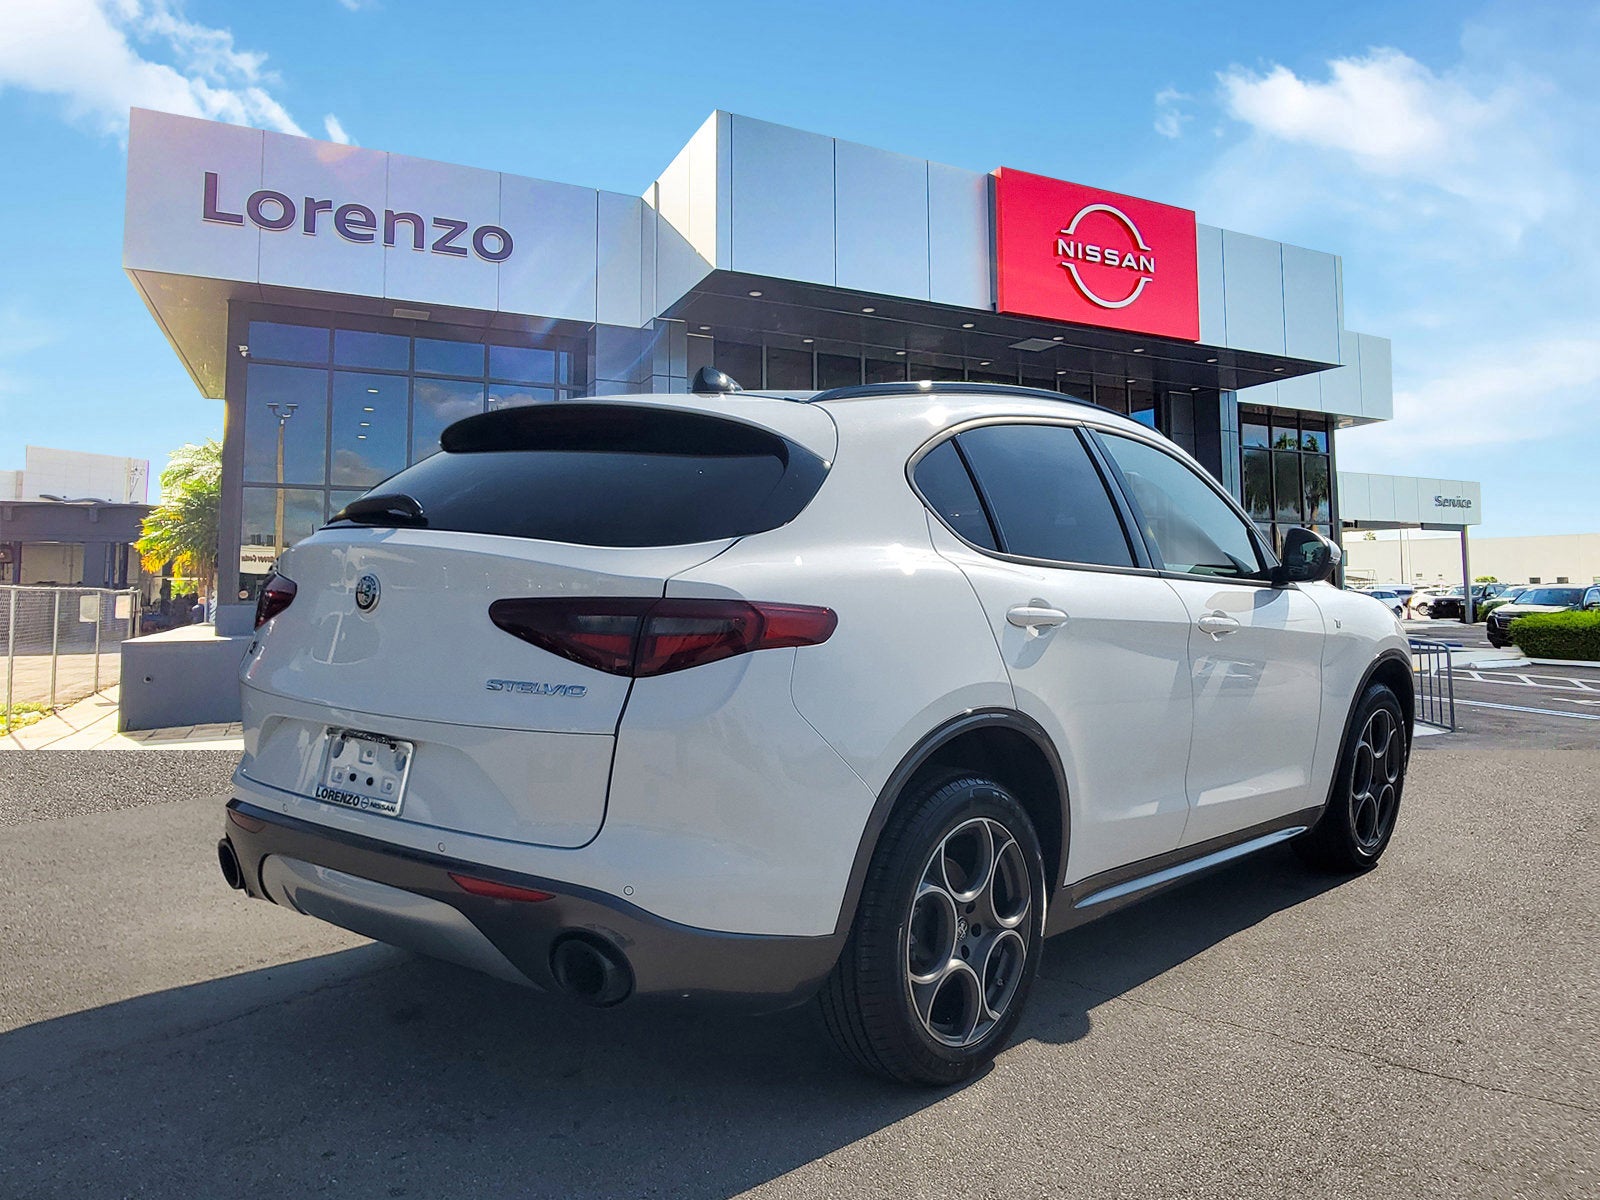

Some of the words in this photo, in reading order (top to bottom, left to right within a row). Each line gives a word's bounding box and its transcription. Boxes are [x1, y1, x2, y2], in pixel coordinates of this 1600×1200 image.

[202, 171, 514, 262] Lorenzo
[1057, 238, 1155, 273] NISSAN
[1434, 495, 1472, 509] Service
[485, 679, 588, 698] STELVIO
[316, 786, 360, 807] LORENZO
[369, 801, 396, 813] NISSAN
